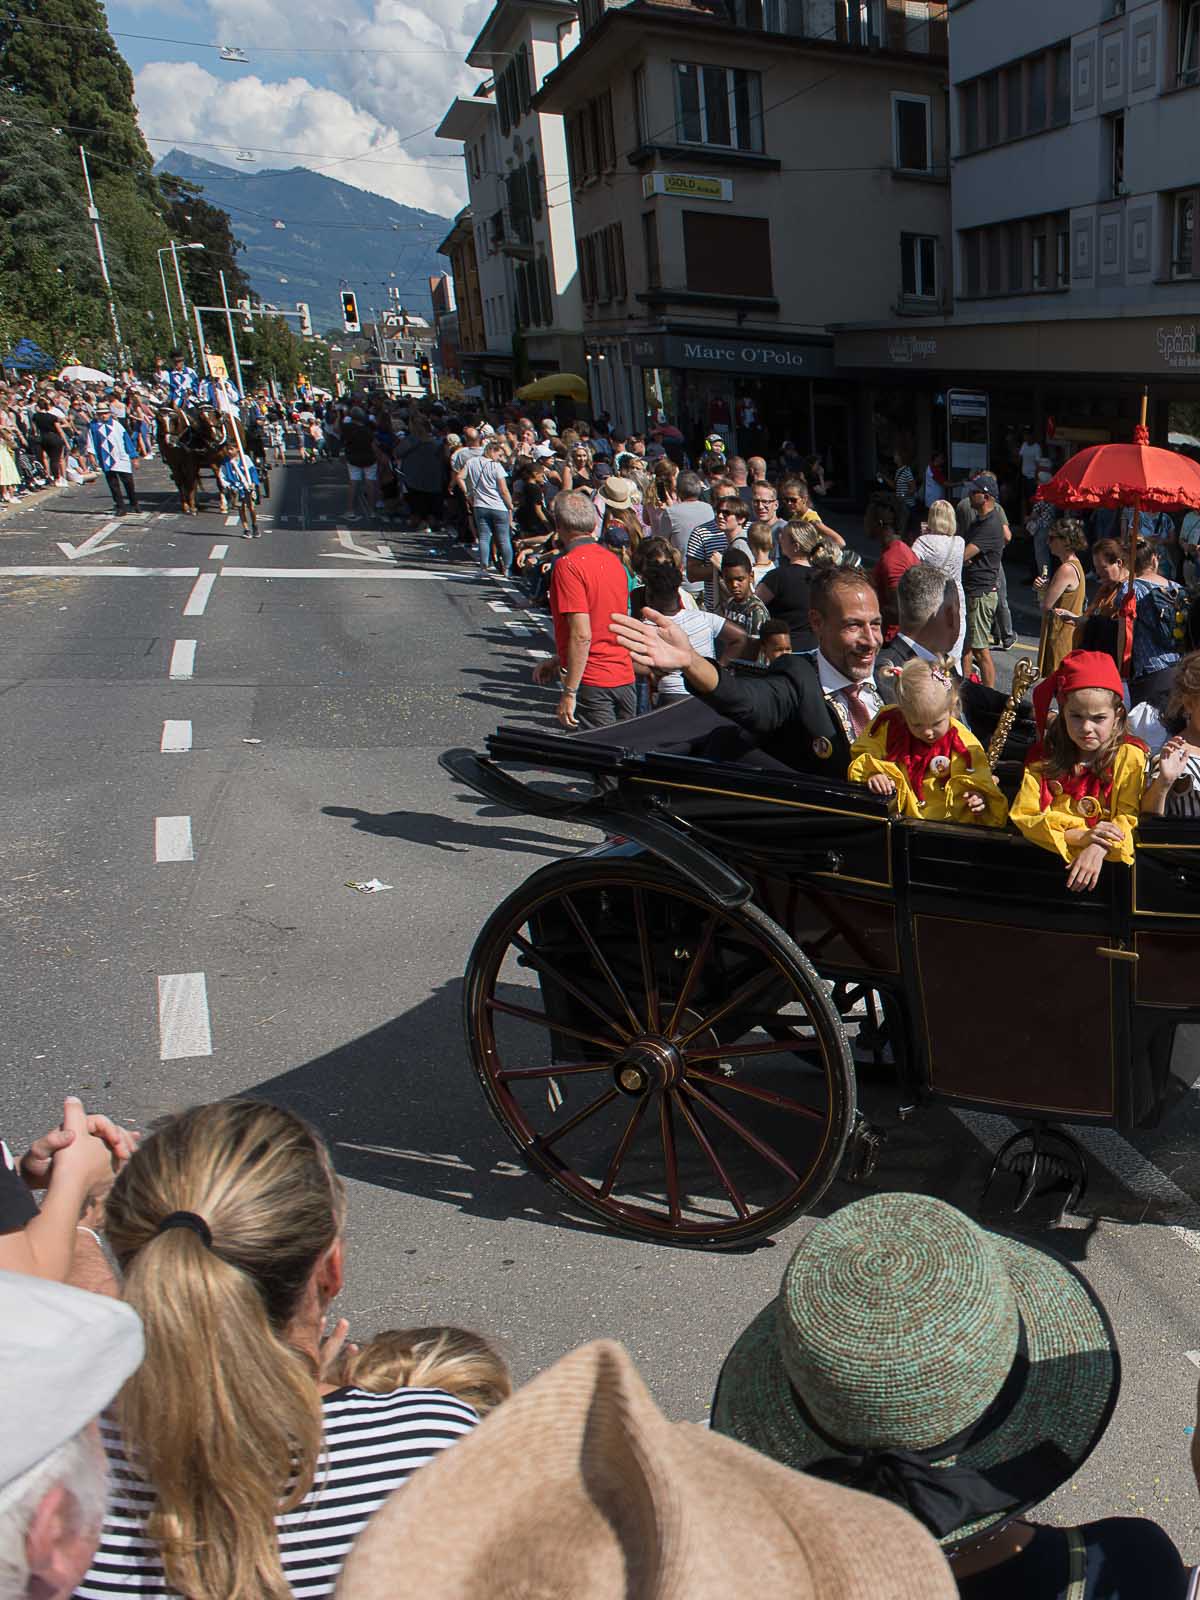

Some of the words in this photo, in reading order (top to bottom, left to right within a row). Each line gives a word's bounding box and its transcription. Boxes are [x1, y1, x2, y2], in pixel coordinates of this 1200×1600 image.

[668, 177, 696, 189] GOLD
[684, 344, 738, 361] Marc
[741, 347, 803, 366] O'Polo
